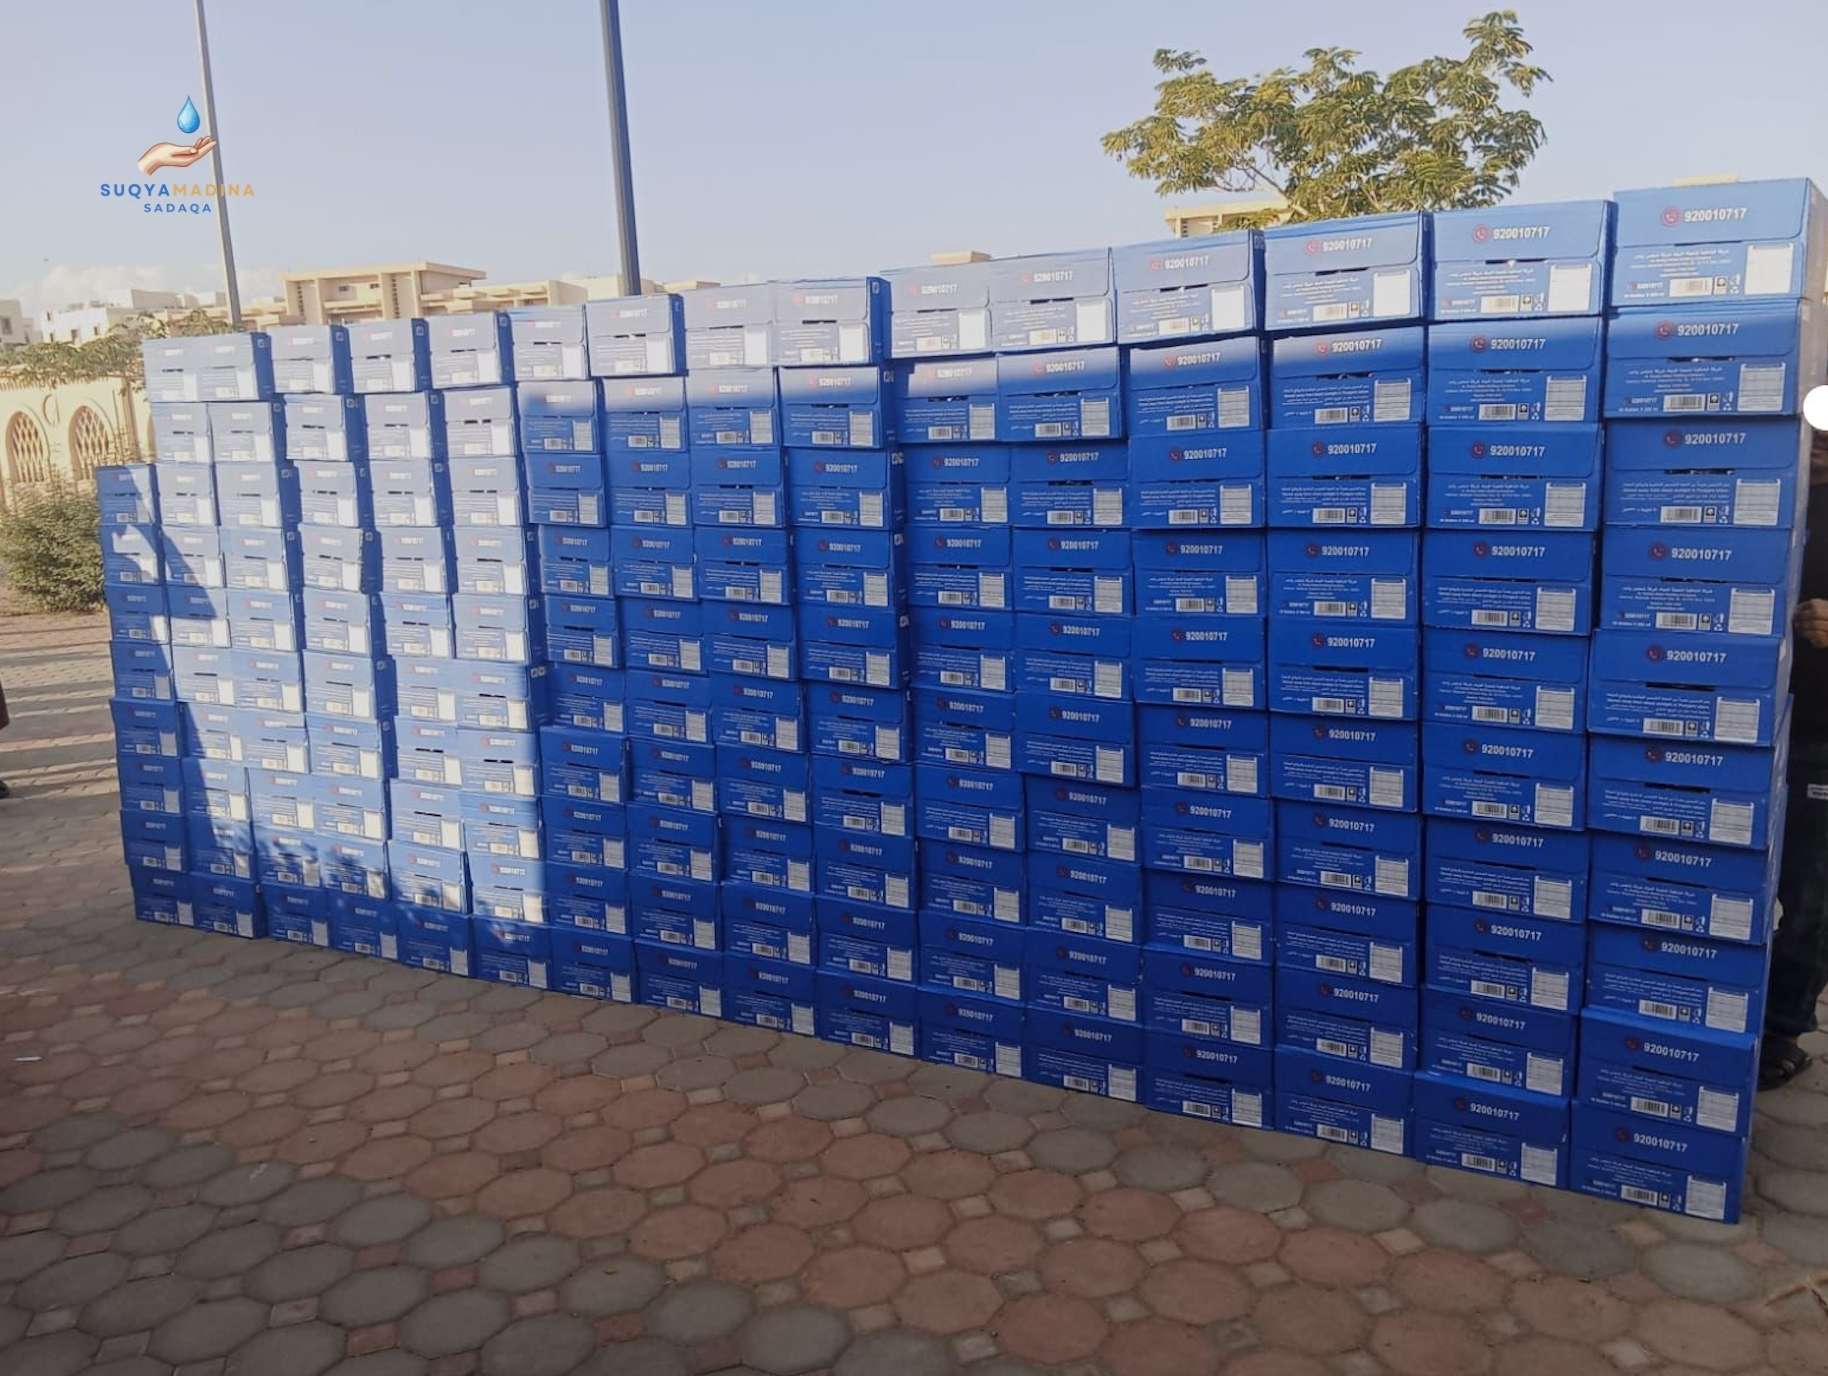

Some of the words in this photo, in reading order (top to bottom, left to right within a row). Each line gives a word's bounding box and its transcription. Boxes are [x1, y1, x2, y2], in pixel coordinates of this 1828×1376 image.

[1684, 207, 1747, 222] 920010717
[1492, 226, 1550, 240] 920010717
[1677, 323, 1739, 337] 920010717
[1491, 338, 1546, 350] 920010717
[1684, 432, 1747, 445] 920010717
[1327, 442, 1377, 455] 920010717
[1489, 445, 1545, 457] 920010717
[1321, 545, 1370, 557] 920010717
[1491, 545, 1546, 557] 920010717
[1671, 547, 1732, 561] 920010717
[1327, 637, 1376, 648] 920010717
[1482, 647, 1536, 662] 920010717
[1666, 649, 1727, 663] 920010717
[1328, 729, 1376, 742] 920010717
[1481, 743, 1534, 759] 920010717
[1665, 751, 1724, 767] 920010717
[1328, 818, 1375, 832] 920010717
[1492, 832, 1544, 848] 920010717
[1654, 849, 1713, 868] 920010717
[1331, 902, 1377, 917] 920010717
[1490, 924, 1542, 941] 920010717
[1661, 941, 1718, 959] 920010717
[1333, 987, 1379, 1003] 920010717
[1476, 1012, 1526, 1030] 920010717
[1643, 1042, 1700, 1062] 920010717
[1325, 1075, 1371, 1092] 920010717
[1470, 1102, 1520, 1121] 920010717
[1633, 1132, 1688, 1153] 920010717
